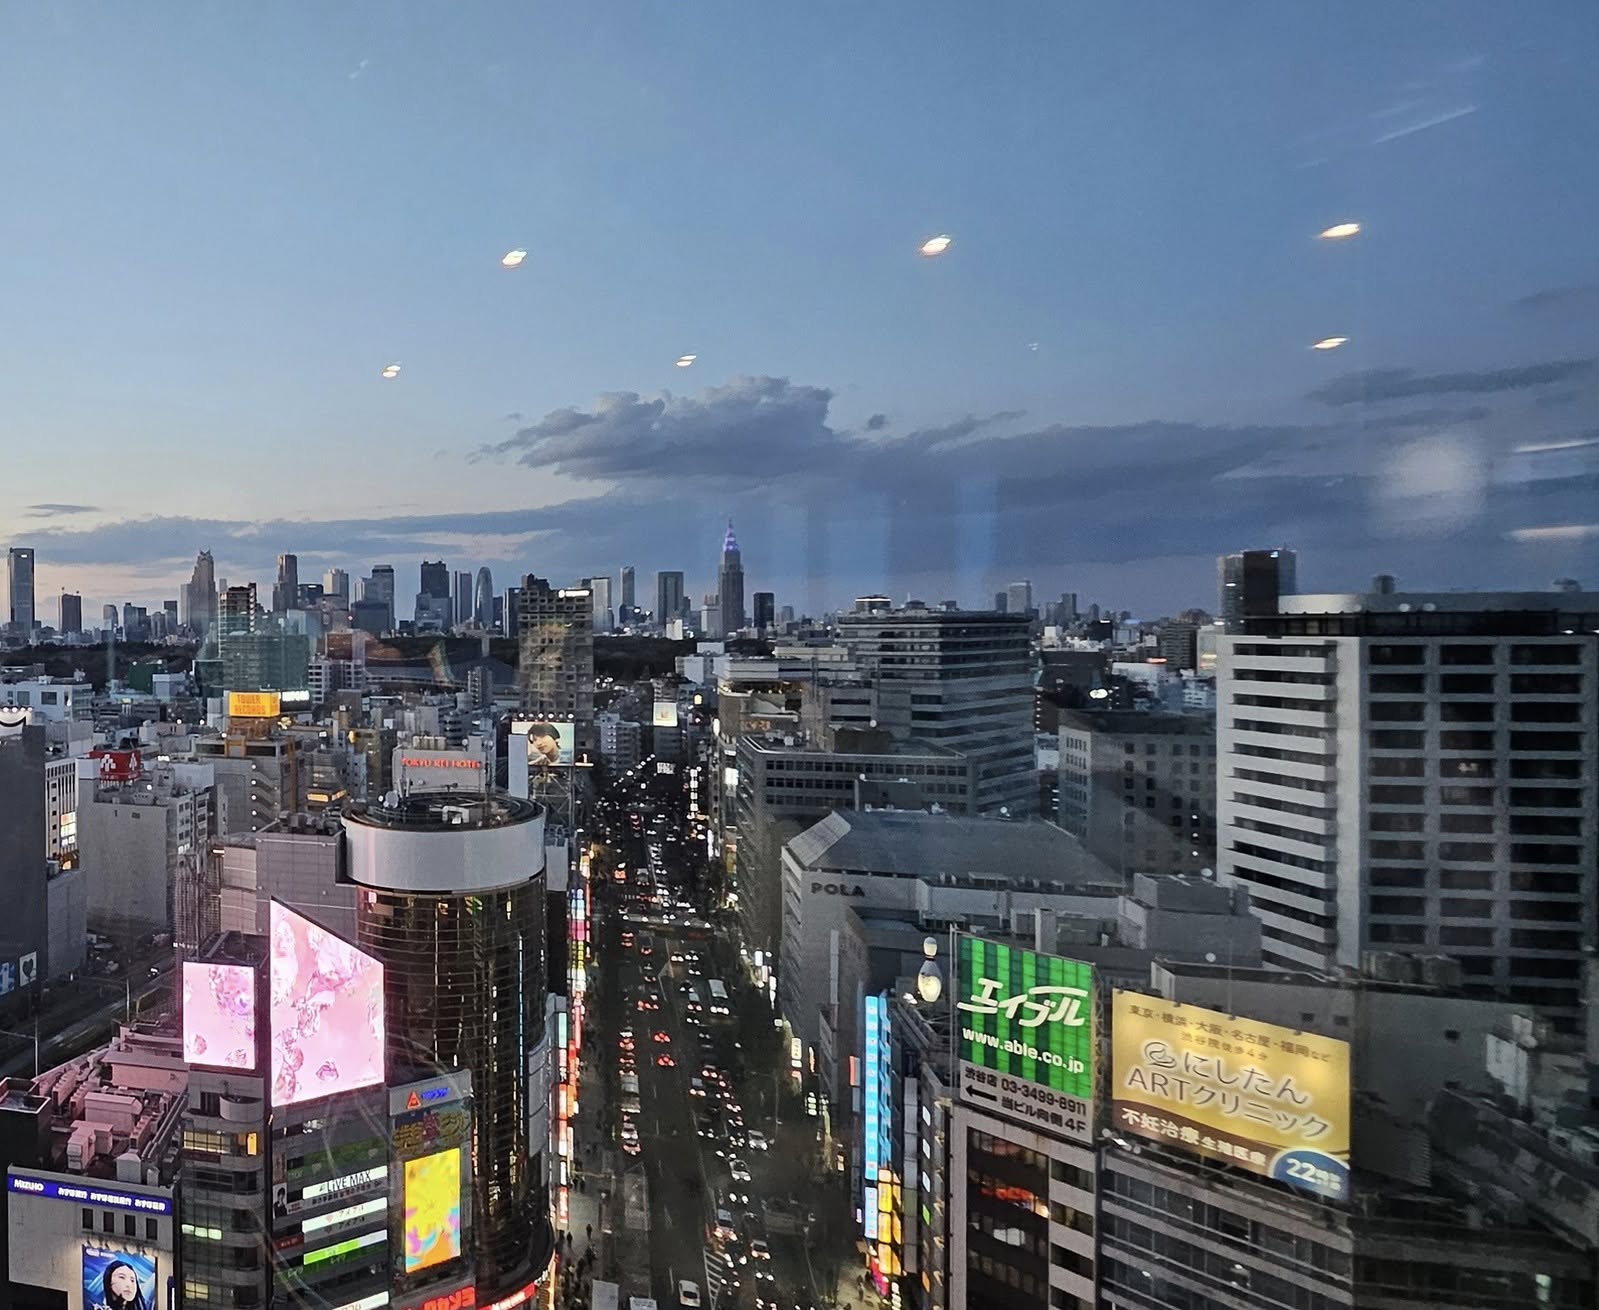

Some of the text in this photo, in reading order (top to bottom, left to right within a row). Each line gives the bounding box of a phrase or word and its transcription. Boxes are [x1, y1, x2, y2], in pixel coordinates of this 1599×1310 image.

[810, 881, 866, 899] POLA
[956, 976, 1089, 1028] エイブル
[962, 1027, 1085, 1074] www.able.co.jp
[964, 1066, 1088, 1117] 渋谷店 03-3499-8911
[1127, 1067, 1329, 1139] ARTクリニック
[1183, 1052, 1309, 1105] にしたん
[14, 1178, 45, 1192] MIZUHO
